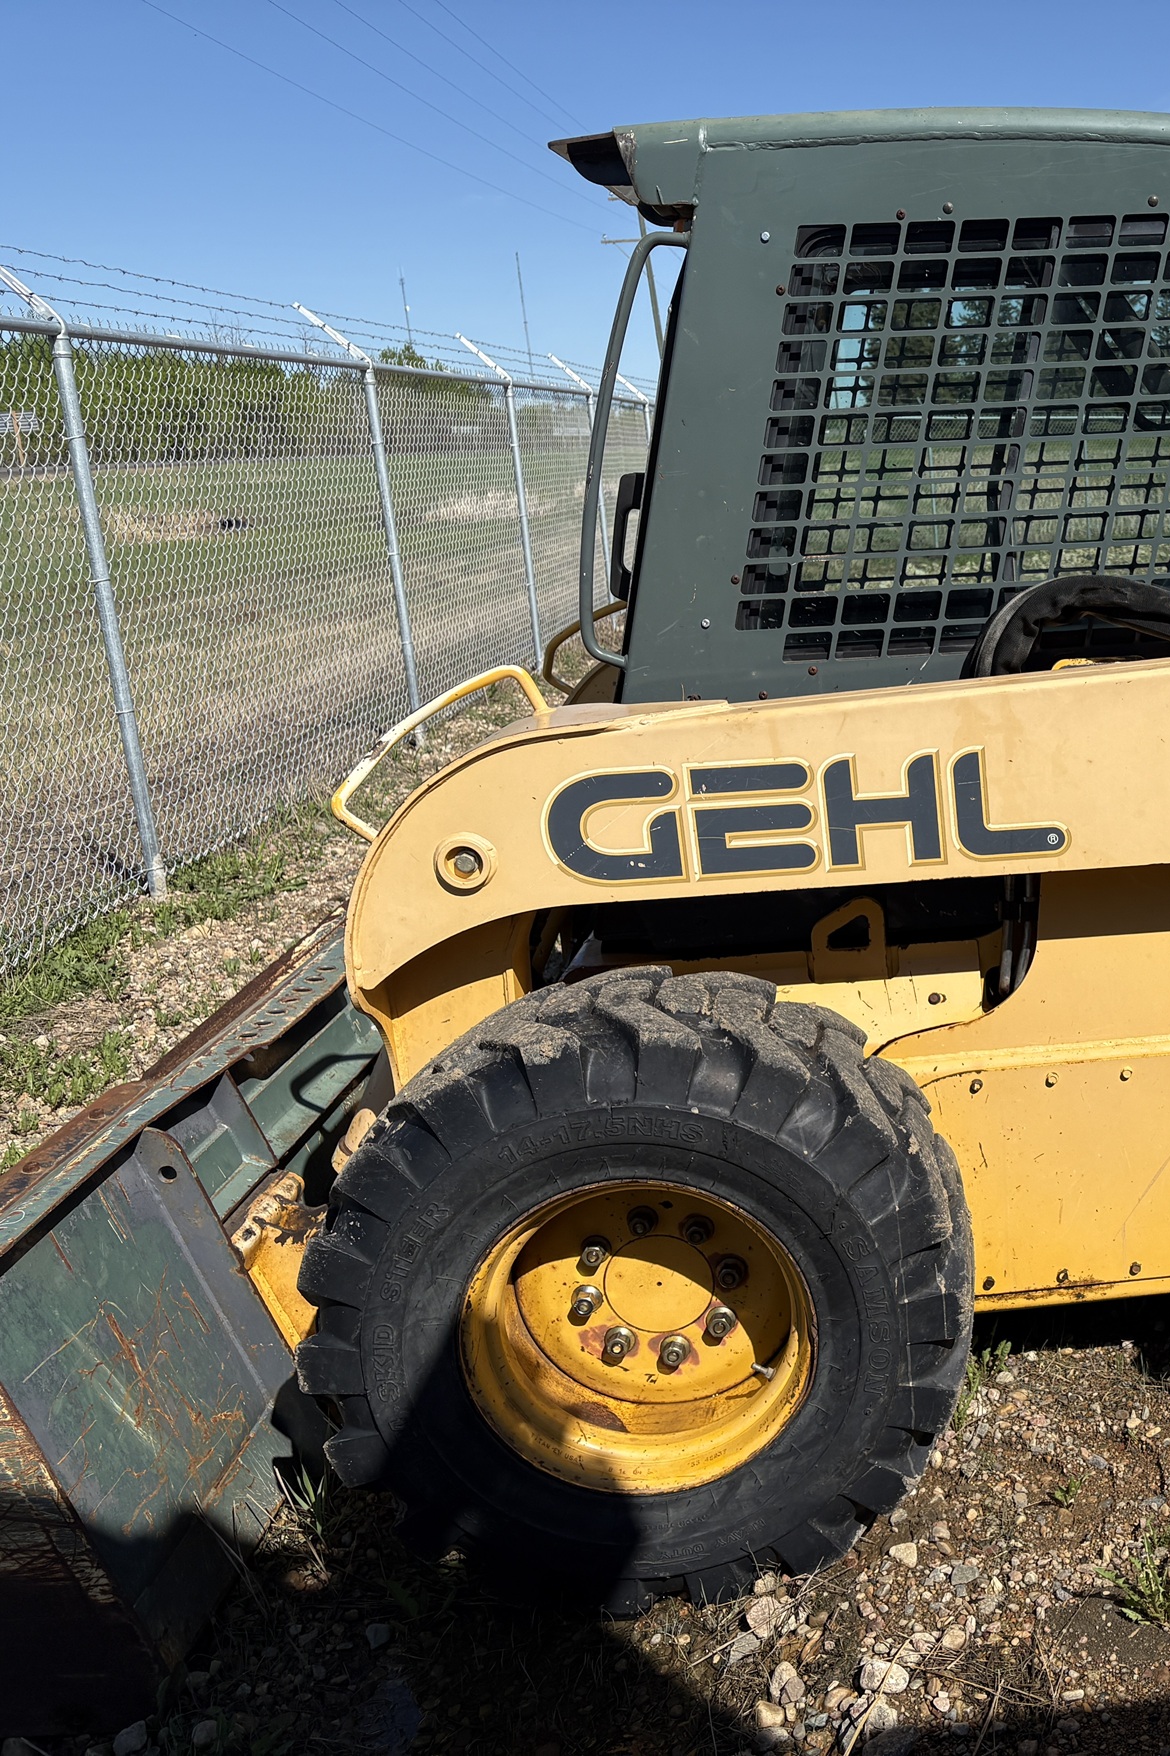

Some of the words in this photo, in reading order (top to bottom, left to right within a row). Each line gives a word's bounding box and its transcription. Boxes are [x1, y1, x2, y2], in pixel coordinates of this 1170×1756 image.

[498, 1115, 705, 1164] 14-17.5NHS
[380, 1202, 451, 1304] STEER
[841, 1235, 892, 1397] SAMSON
[372, 1323, 401, 1404] SKID
[658, 1543, 705, 1562] DUTY
